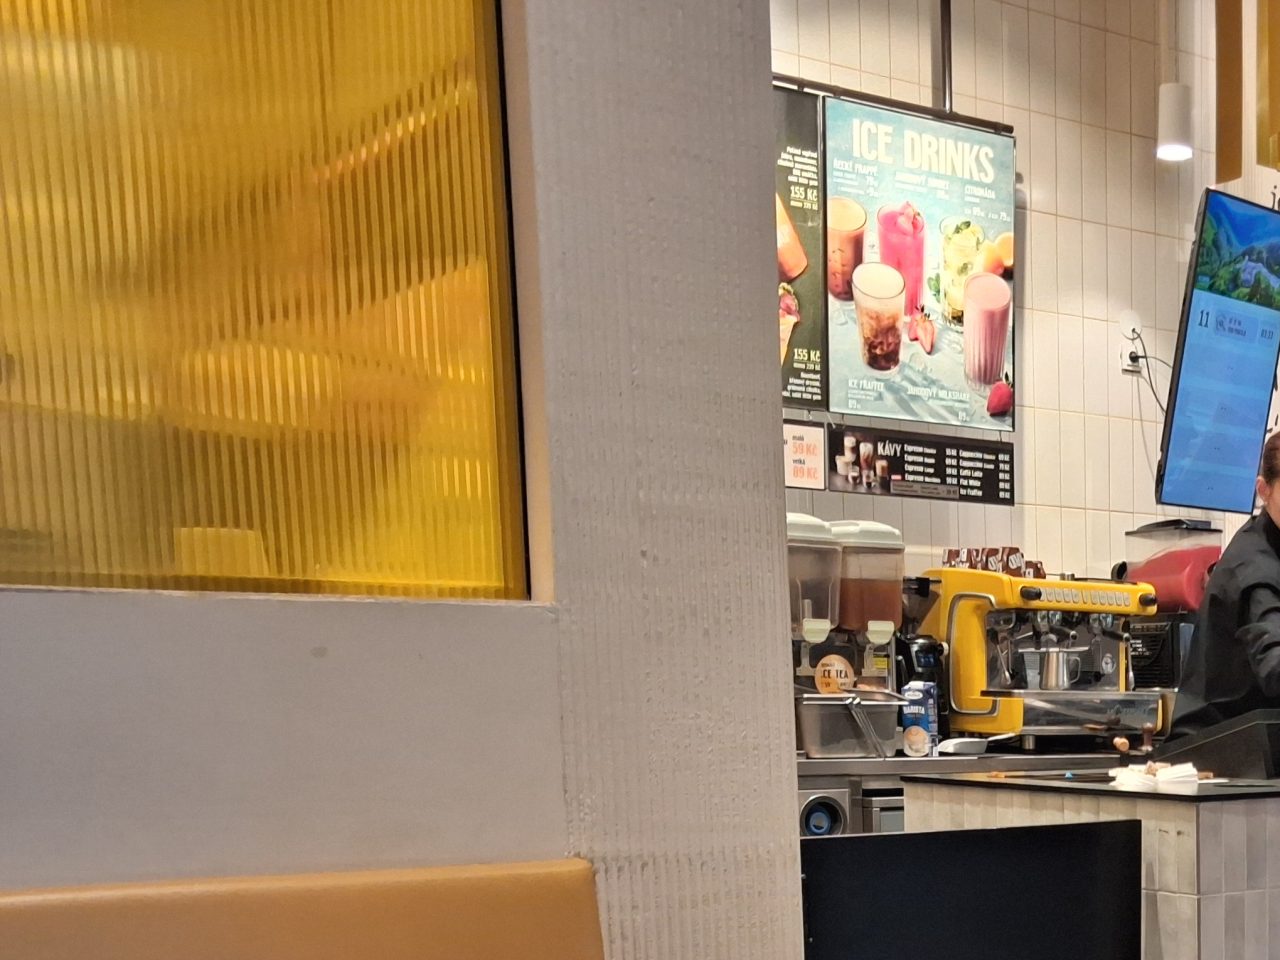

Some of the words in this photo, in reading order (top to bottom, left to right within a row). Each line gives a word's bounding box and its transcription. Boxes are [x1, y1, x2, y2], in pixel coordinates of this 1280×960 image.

[852, 119, 894, 165] ICE
[903, 130, 995, 184] DRINKS
[790, 185, 805, 199] 155
[807, 188, 818, 202] Kč
[794, 348, 808, 361] 155
[877, 440, 902, 457] KÁVY
